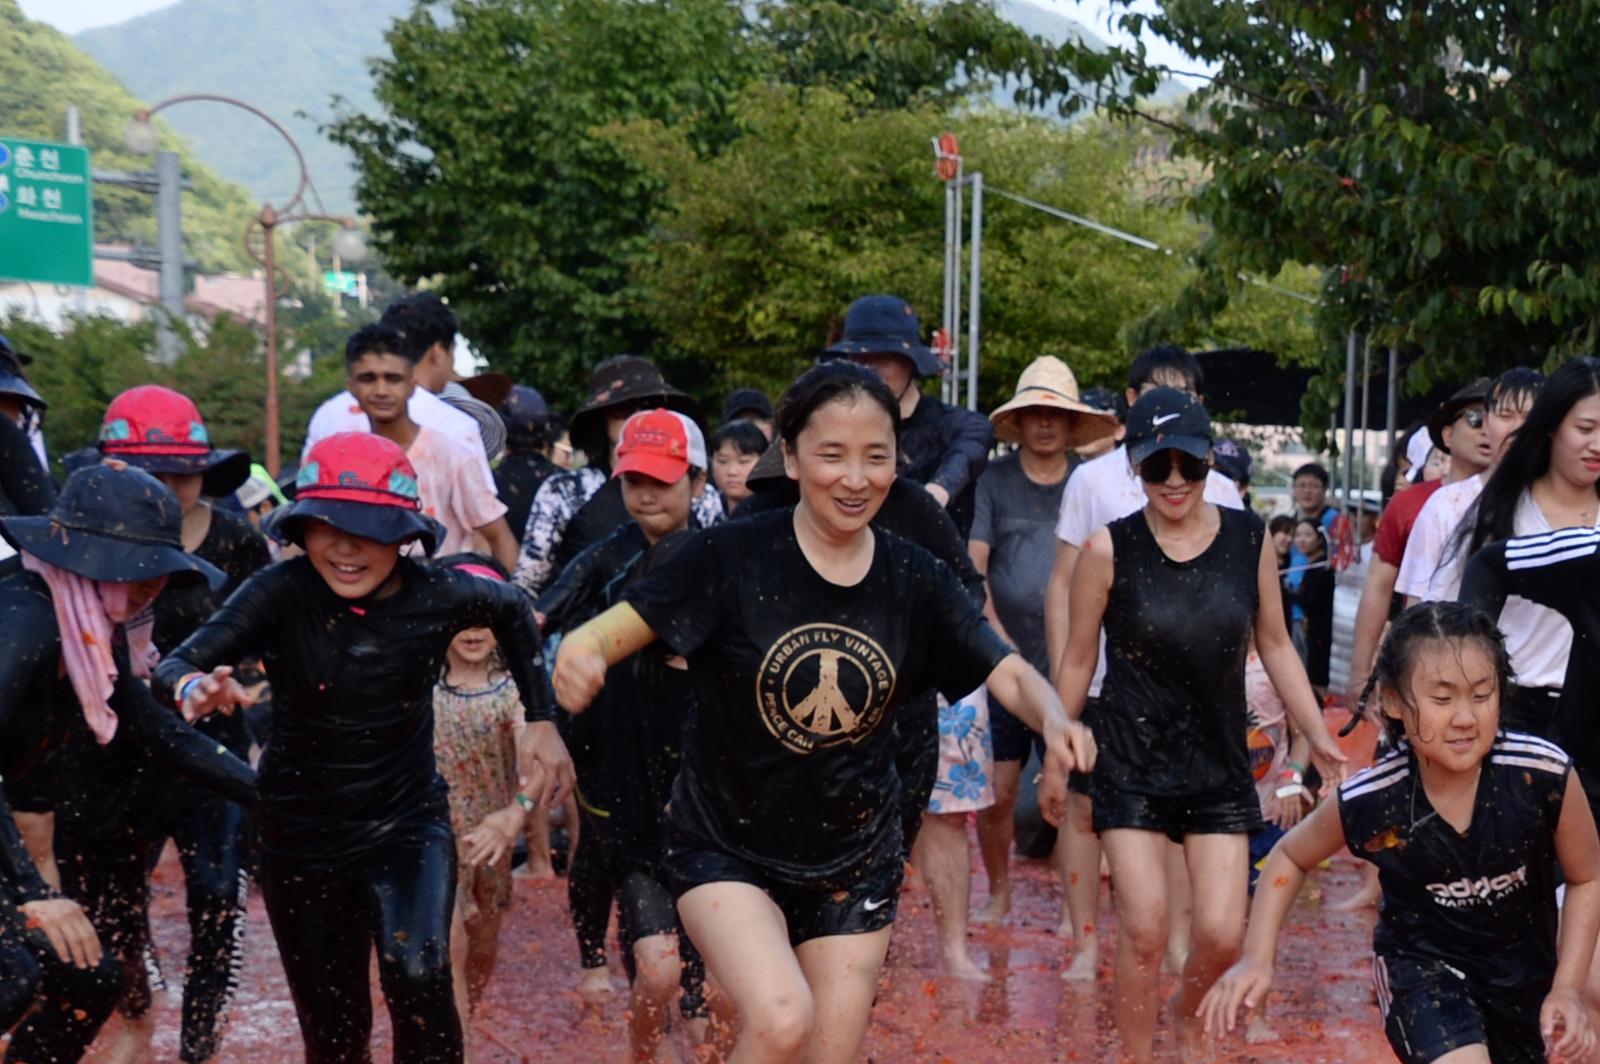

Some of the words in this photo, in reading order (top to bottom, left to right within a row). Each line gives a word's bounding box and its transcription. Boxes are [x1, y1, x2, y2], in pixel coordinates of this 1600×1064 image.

[768, 634, 811, 674] URBAN
[814, 631, 840, 643] FLY
[844, 636, 890, 690] VINTAGE
[765, 692, 789, 733] PEACE
